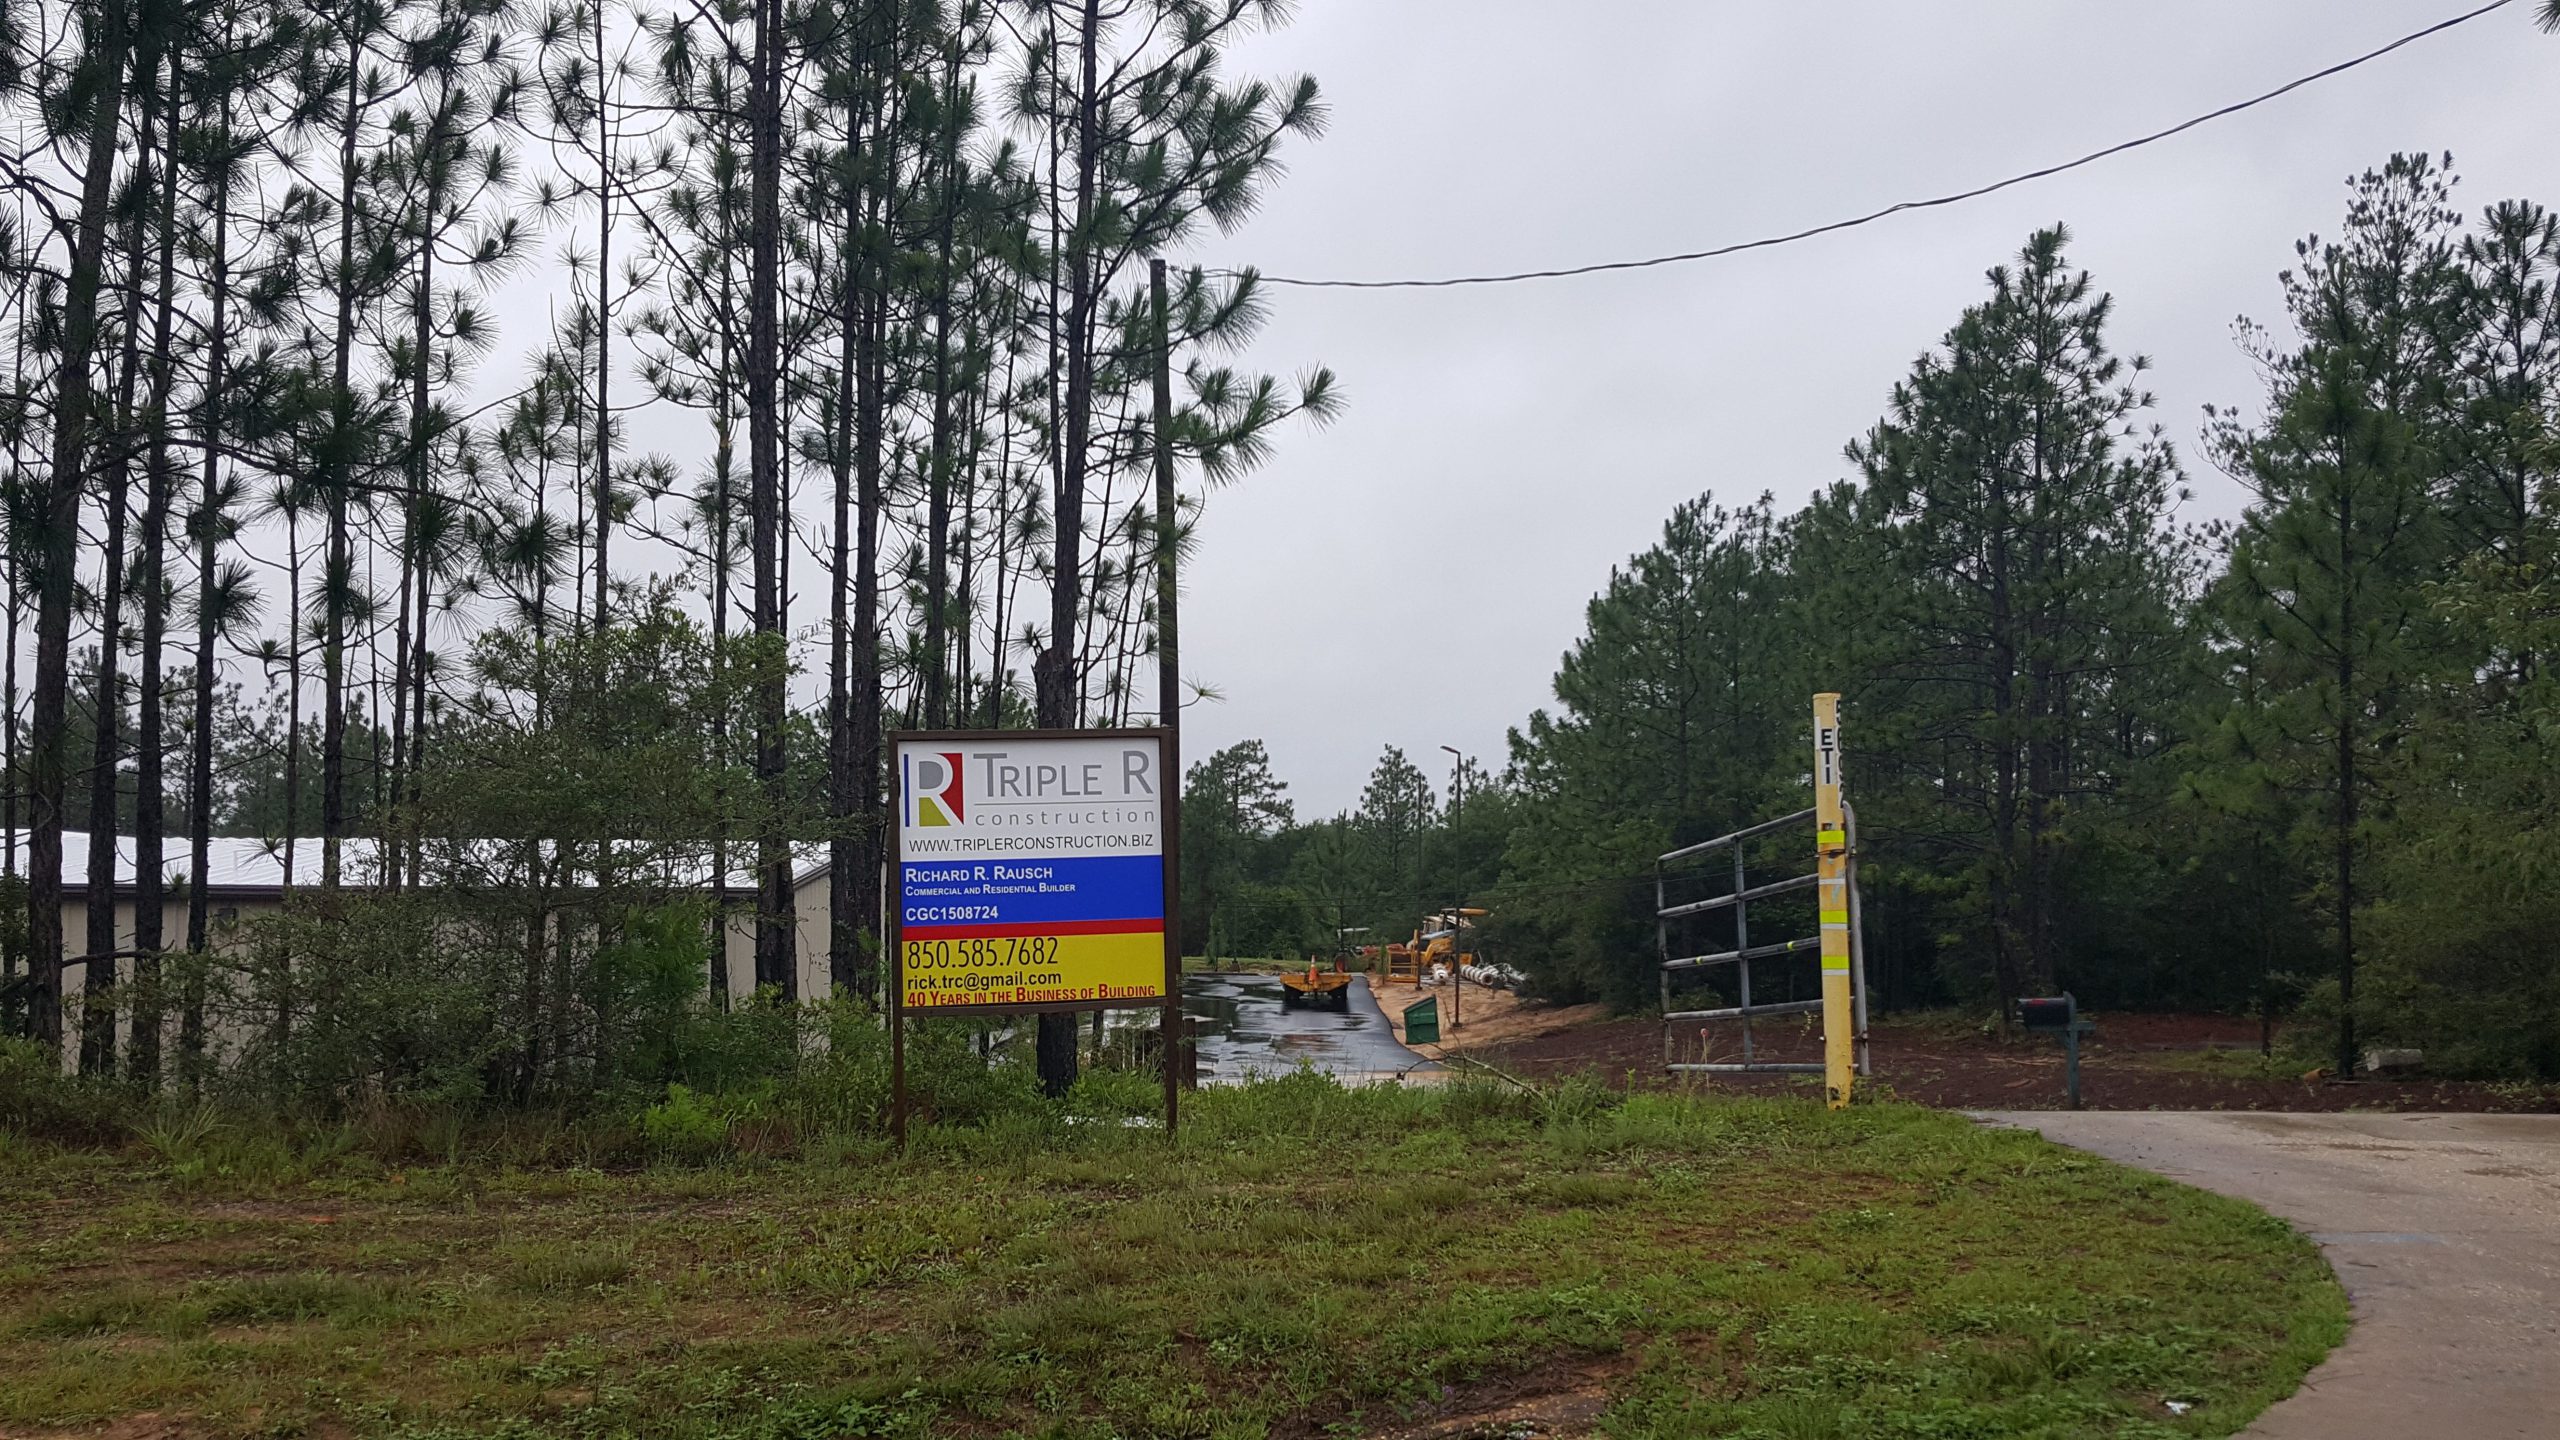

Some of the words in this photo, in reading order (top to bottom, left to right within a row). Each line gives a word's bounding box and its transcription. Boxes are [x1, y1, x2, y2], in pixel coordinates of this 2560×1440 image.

[973, 753, 1102, 797] TRIPLE
[1123, 750, 1154, 794] R
[975, 808, 1154, 826] construction
[909, 834, 1153, 852] WWW.TRIPLERCONSTRUCTION.BIZ
[905, 868, 970, 882] RICHARD
[974, 866, 990, 880] R.
[994, 865, 1053, 880] RAUSCH
[905, 886, 962, 896] COMMERCIAL
[963, 886, 981, 894] AND
[983, 884, 1037, 894] RESIDENTIAL
[1039, 882, 1076, 893] BUILDER
[905, 906, 999, 921] CGC1508724
[908, 937, 1058, 969] 850.585.7682
[907, 971, 1062, 991] rick.trc@gmail.com
[907, 992, 926, 1007] 40
[930, 991, 970, 1006] YEARS
[974, 993, 987, 1003] IN
[990, 991, 1012, 1003] THE
[1016, 987, 1077, 1001] BUSINESS
[1080, 988, 1094, 999] OF
[1098, 984, 1156, 998] BUILDING
